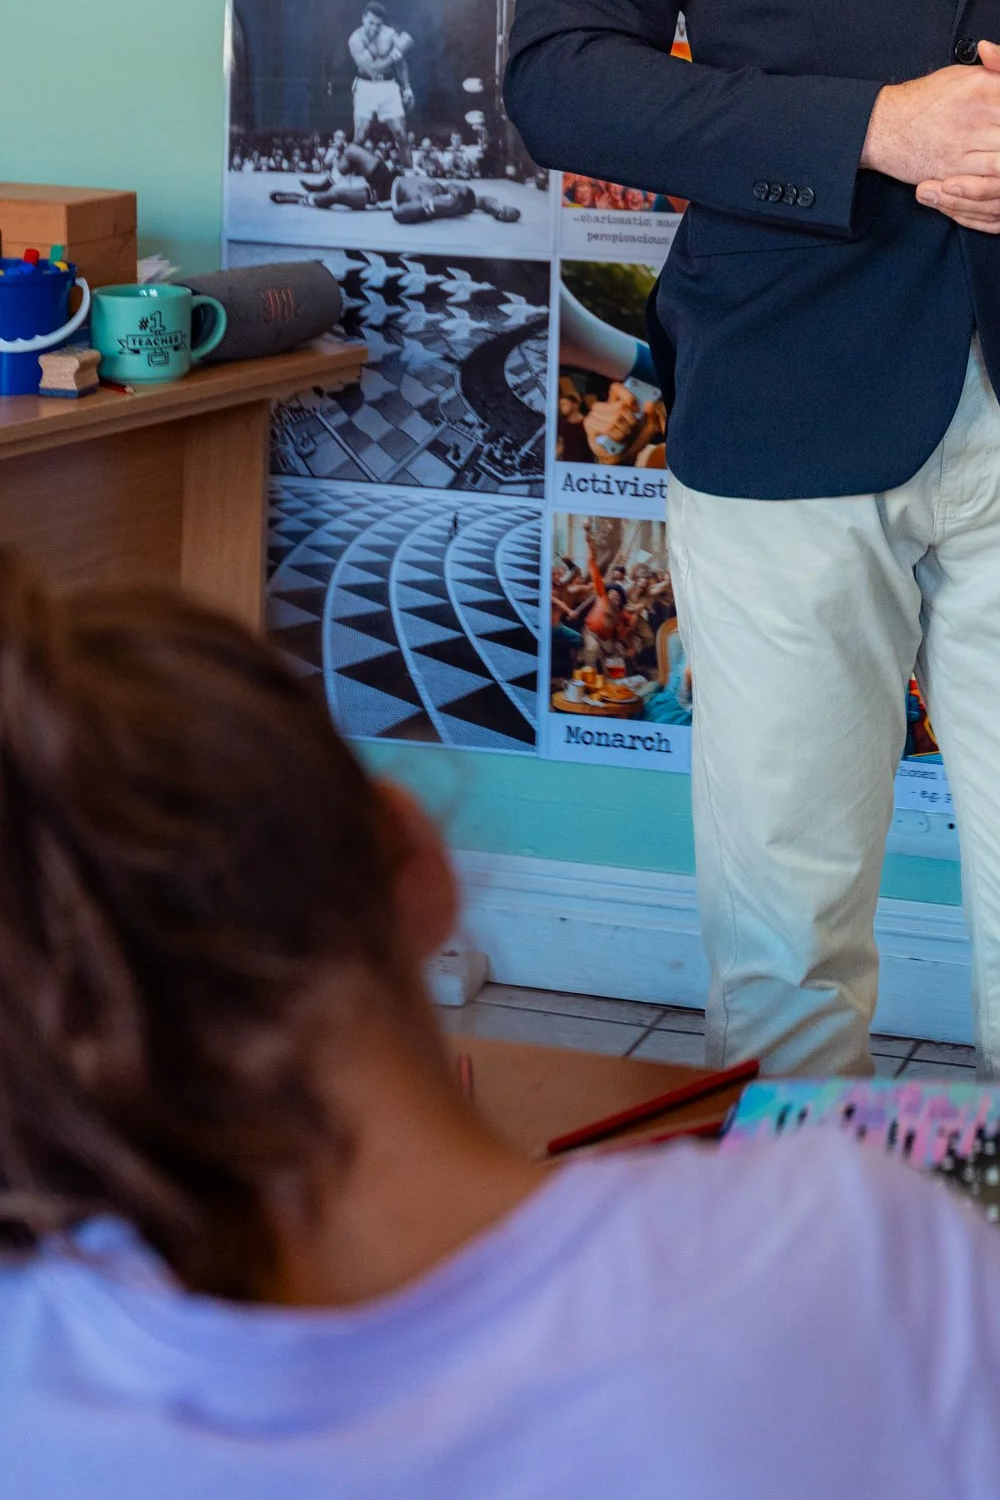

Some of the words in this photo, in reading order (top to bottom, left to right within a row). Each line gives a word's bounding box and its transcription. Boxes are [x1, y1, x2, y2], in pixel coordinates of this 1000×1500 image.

[138, 309, 167, 333] #1
[131, 334, 179, 347] TEACHER
[561, 470, 668, 501] Activist
[565, 723, 671, 754] Monarch
